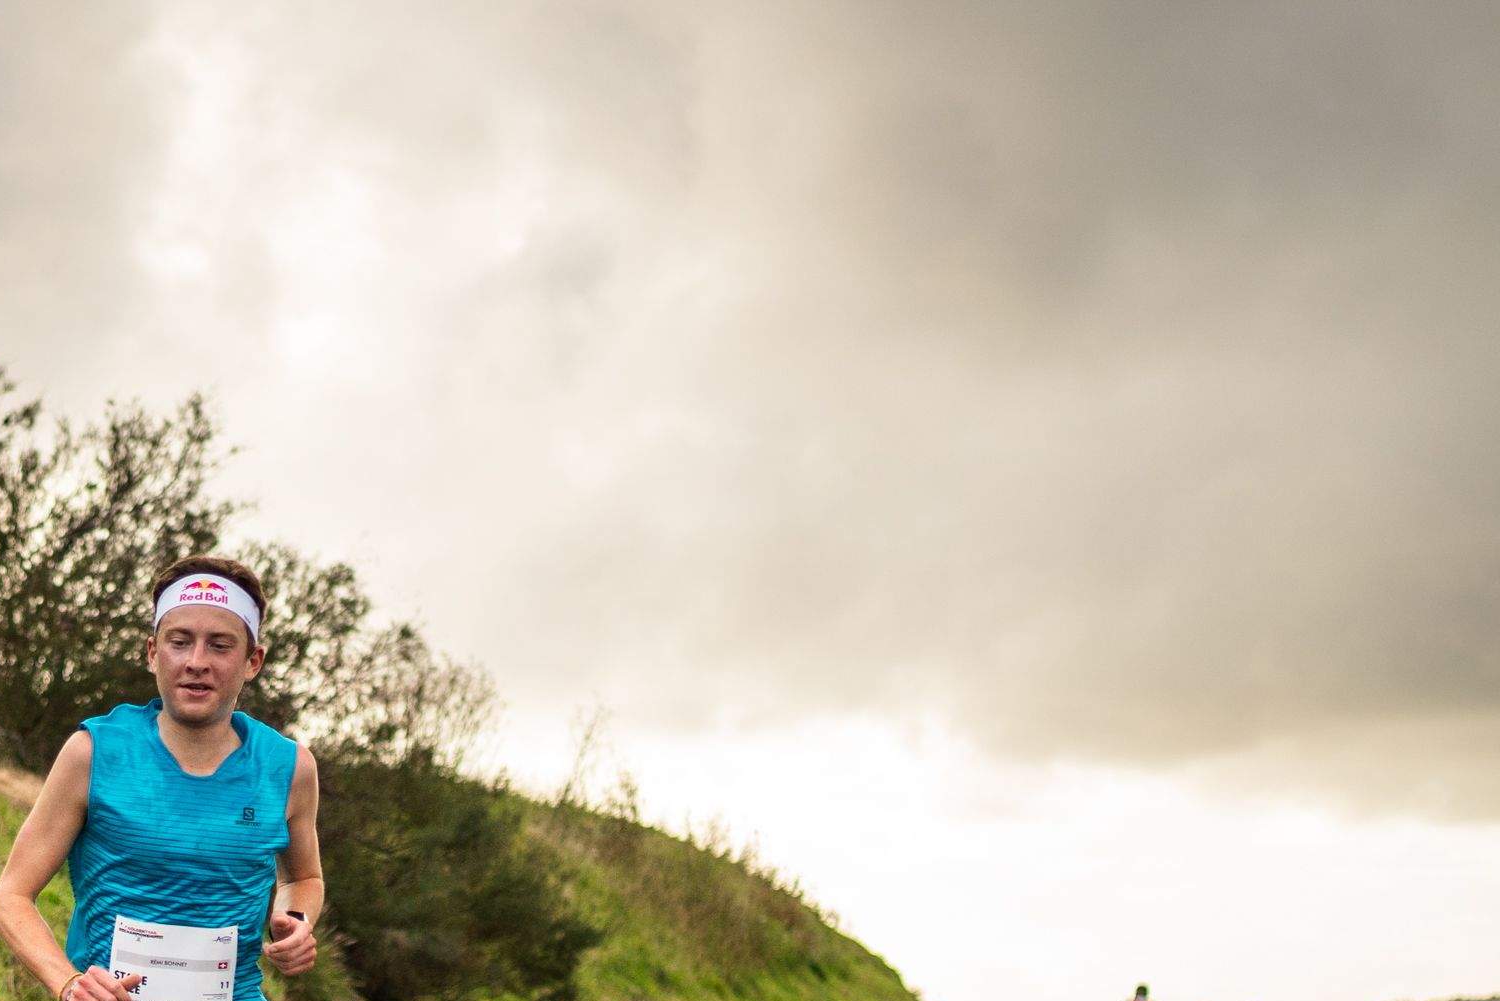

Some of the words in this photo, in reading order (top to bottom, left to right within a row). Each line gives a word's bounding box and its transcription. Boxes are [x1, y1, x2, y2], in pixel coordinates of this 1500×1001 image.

[180, 592, 203, 602] Red
[205, 593, 228, 604] Bull
[114, 970, 148, 985] STE
[220, 981, 229, 989] 11
